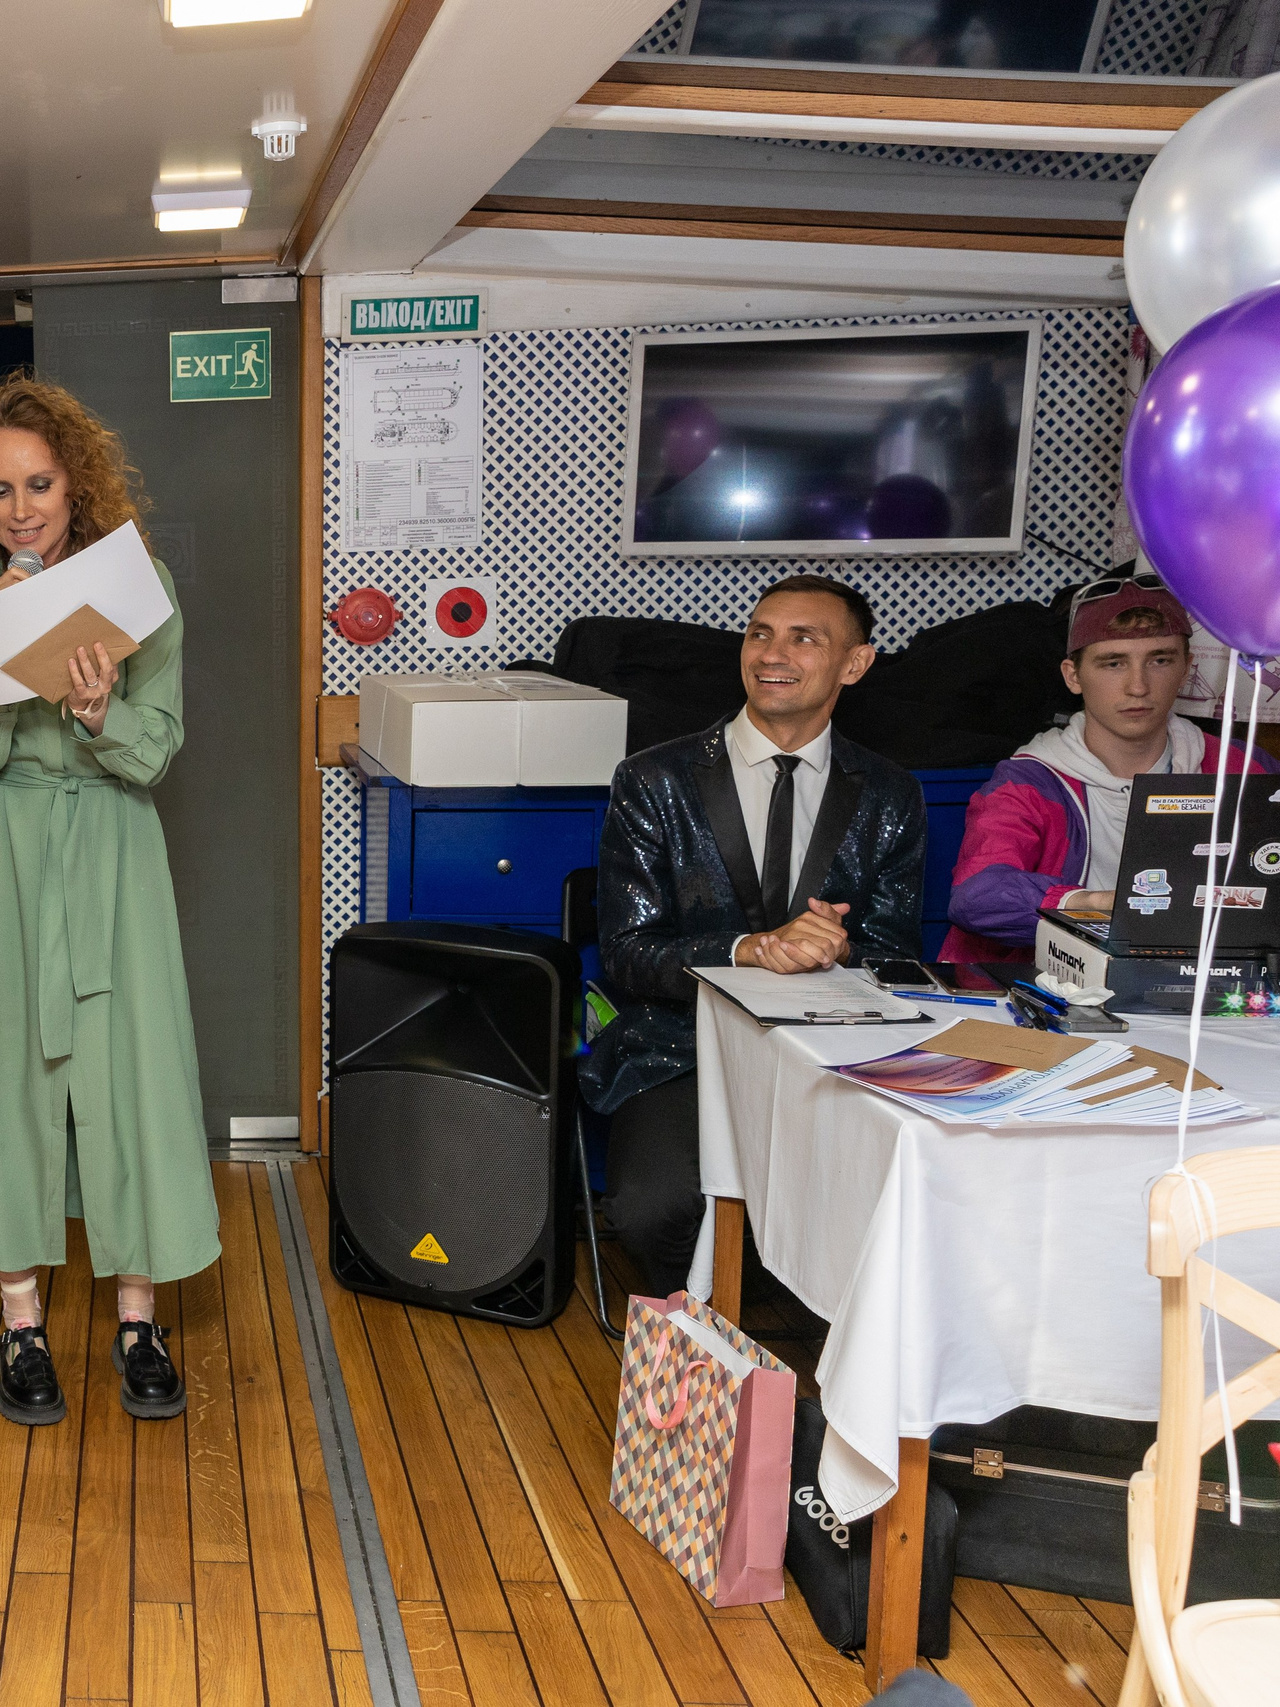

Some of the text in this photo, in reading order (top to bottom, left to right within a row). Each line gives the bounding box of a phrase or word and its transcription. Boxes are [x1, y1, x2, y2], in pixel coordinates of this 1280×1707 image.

[355, 299, 474, 331] ВЫХОД/EXIT
[176, 355, 233, 378] EXIT
[1048, 939, 1086, 974] Numark
[1048, 958, 1069, 981] PARTY
